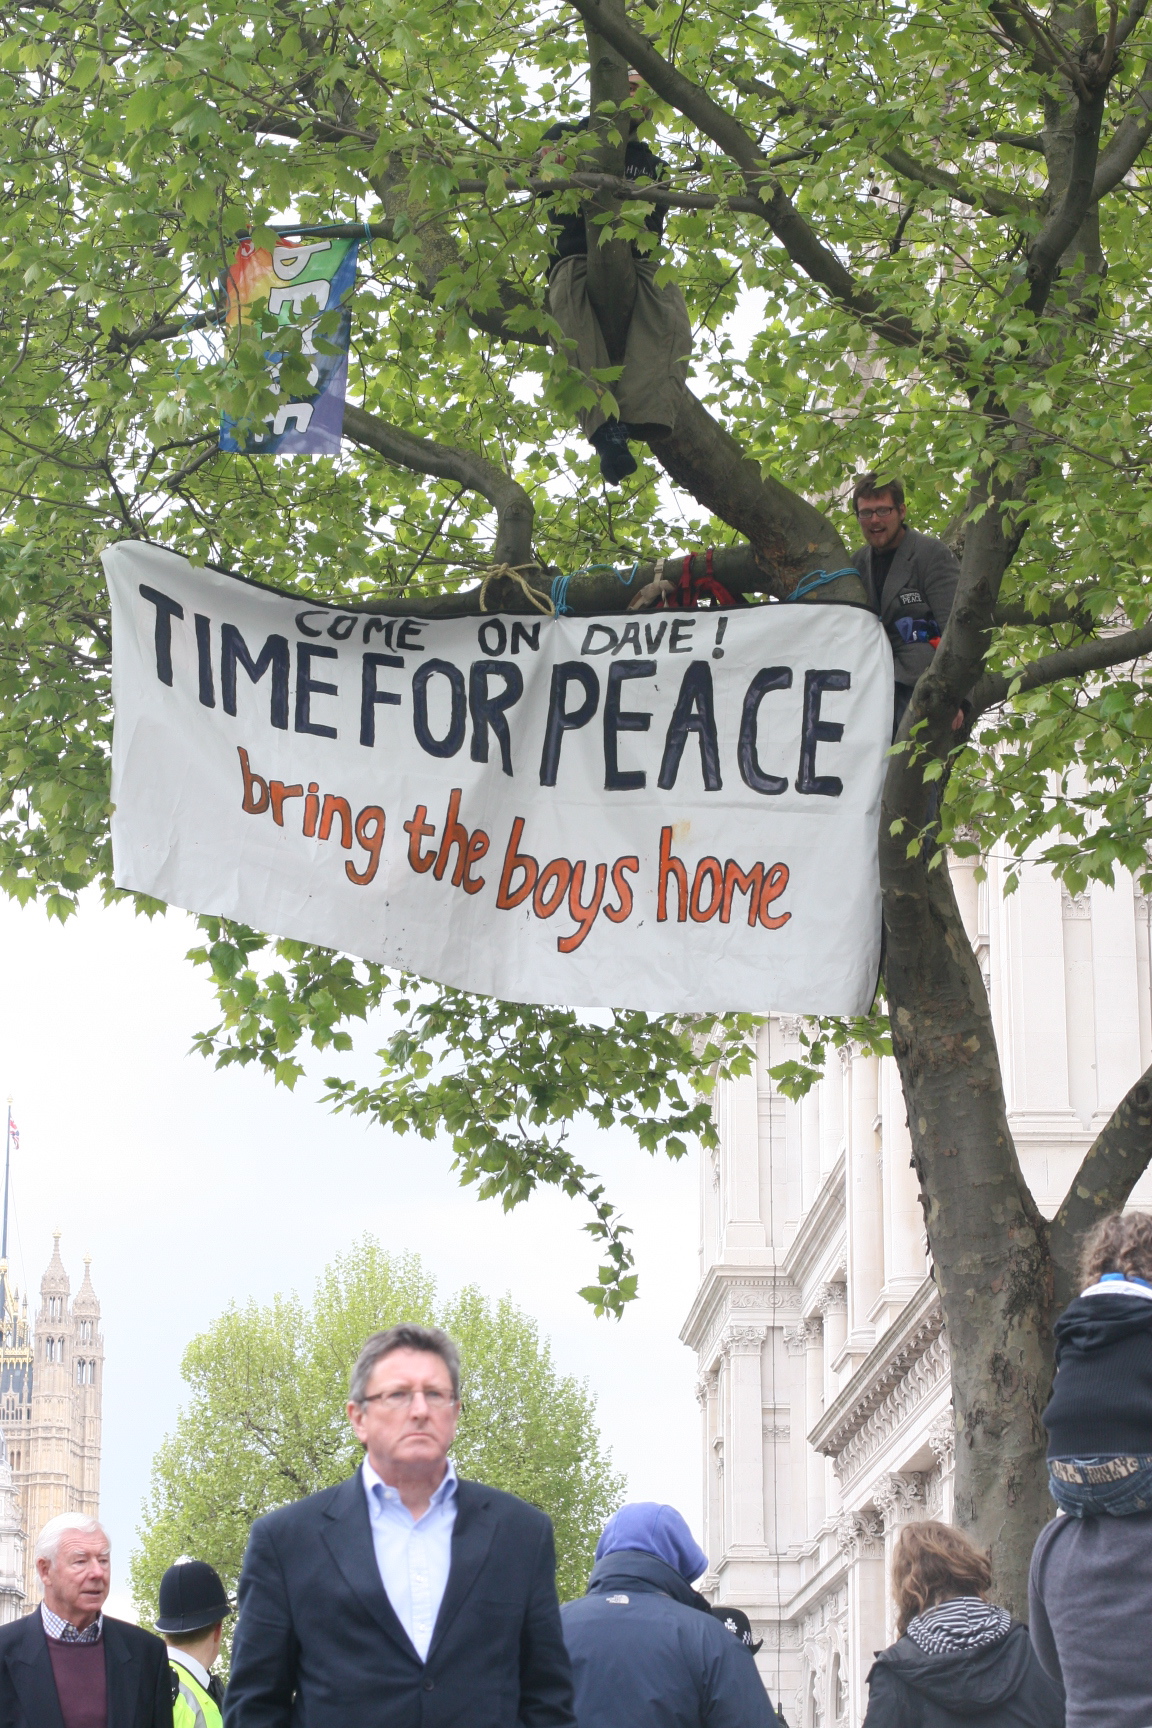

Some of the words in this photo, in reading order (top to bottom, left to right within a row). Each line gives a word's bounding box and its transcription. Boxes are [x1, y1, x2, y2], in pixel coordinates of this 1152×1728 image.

[139, 583, 339, 739] TIME
[360, 652, 523, 777] FOR
[539, 659, 851, 797] PEACE
[295, 610, 429, 652] COME
[478, 617, 540, 657] ON
[237, 746, 386, 885] bring
[403, 788, 490, 895] the
[496, 816, 639, 953] boys
[657, 826, 791, 930] home
